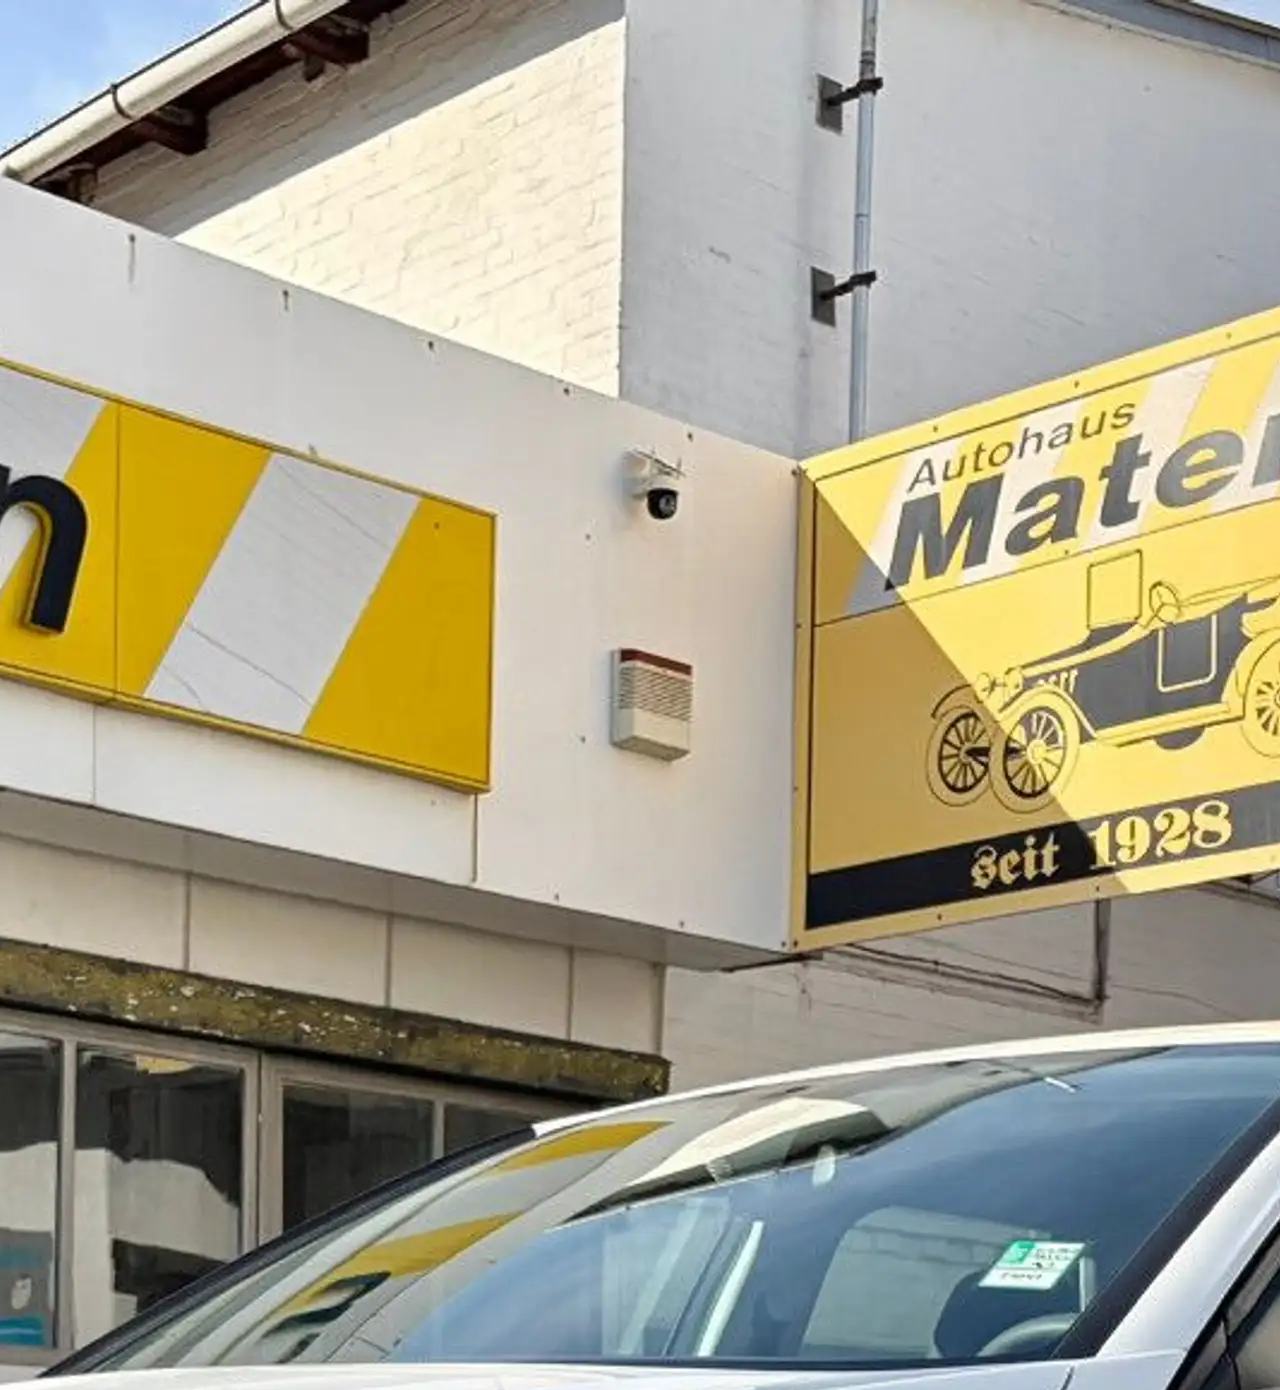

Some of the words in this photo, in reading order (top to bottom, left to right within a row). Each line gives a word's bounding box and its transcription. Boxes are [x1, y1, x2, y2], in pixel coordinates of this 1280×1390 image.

[908, 399, 1137, 494] Autohaus
[971, 838, 1061, 889] seit
[1088, 800, 1232, 867] 1928
